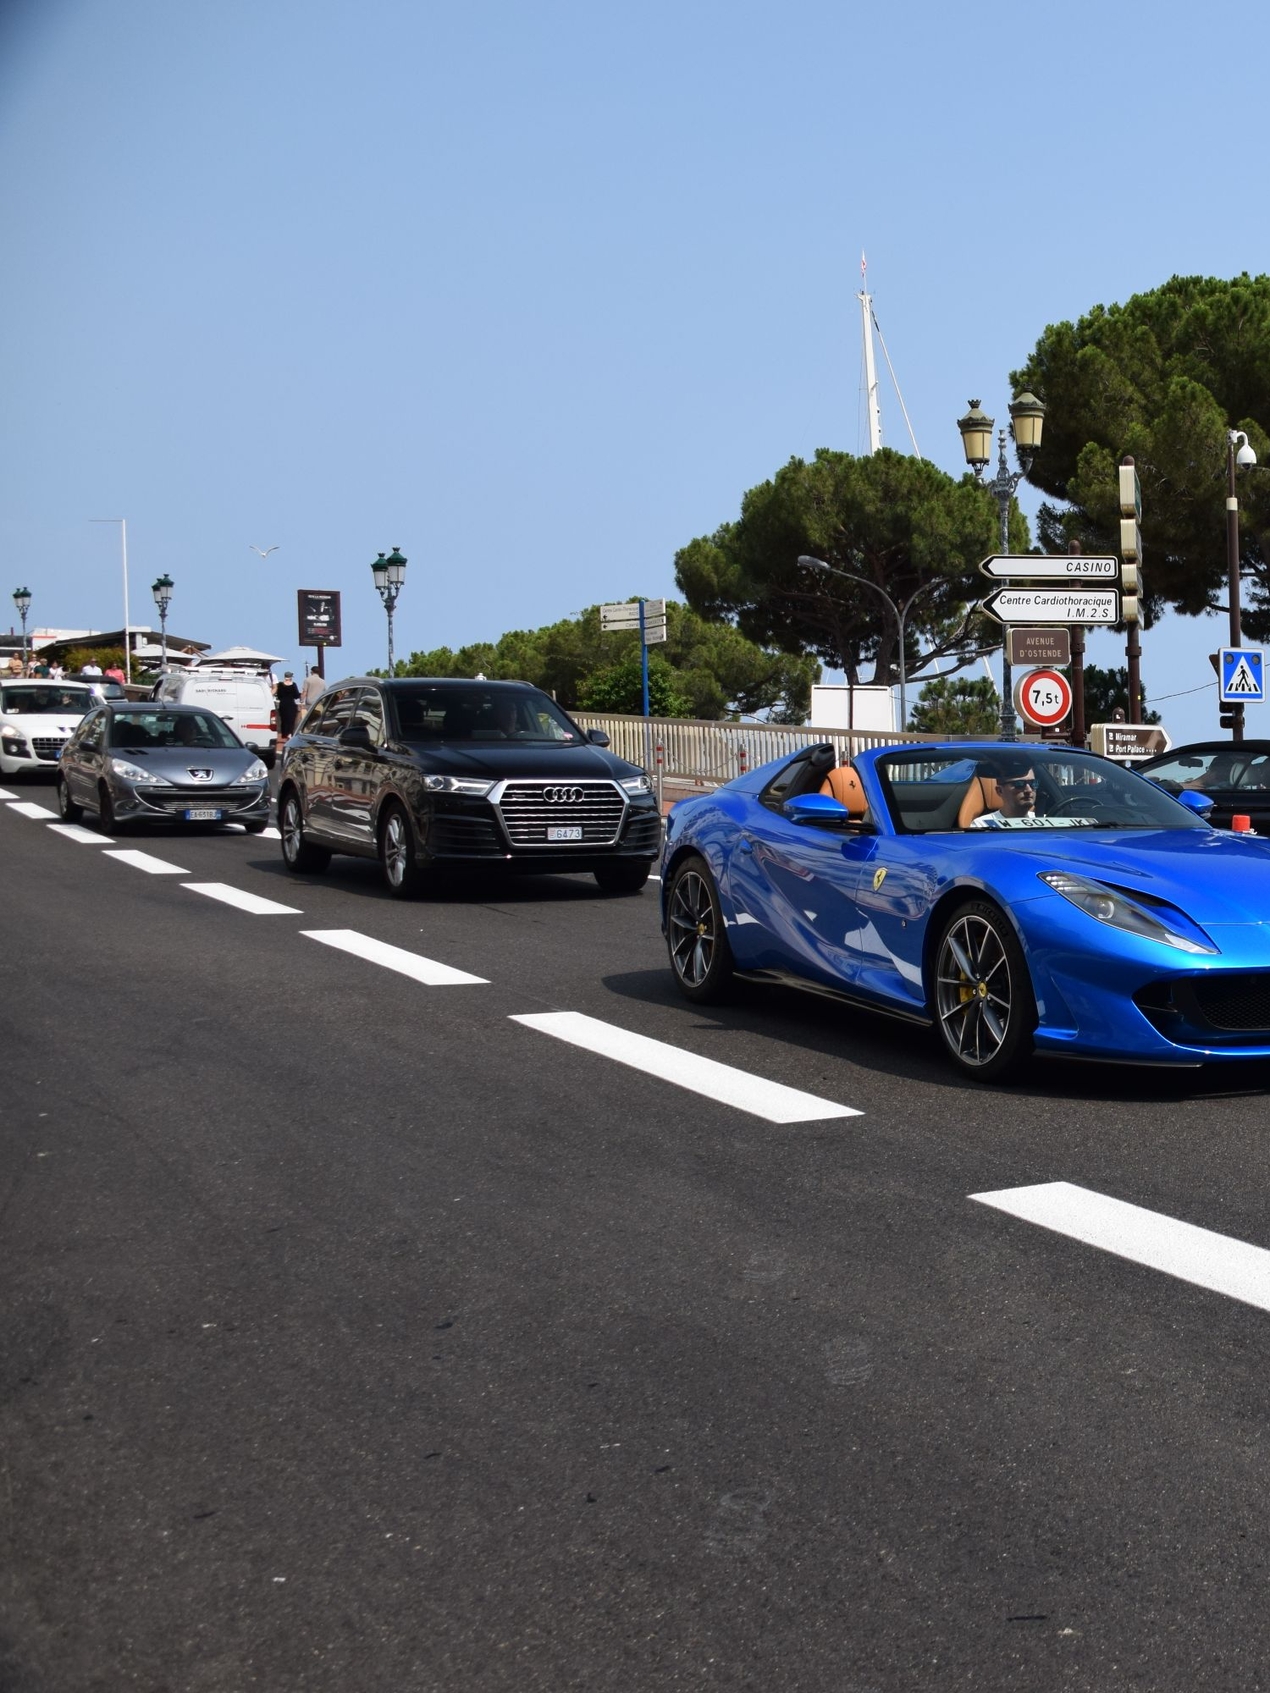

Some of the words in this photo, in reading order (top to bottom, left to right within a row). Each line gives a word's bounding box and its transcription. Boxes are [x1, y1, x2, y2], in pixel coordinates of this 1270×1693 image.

[1066, 562, 1112, 573] CASINO
[999, 595, 1031, 605] Centre
[1034, 595, 1113, 607] Cardiothoracique
[1067, 609, 1113, 618] I.M.2.S.
[1026, 637, 1055, 646] AVENUE
[1019, 650, 1062, 658] D'OSTENDE
[1115, 733, 1137, 741] Miramar
[1115, 745, 1127, 753] Port
[1127, 745, 1145, 753] Palace
[556, 829, 581, 838] 6473
